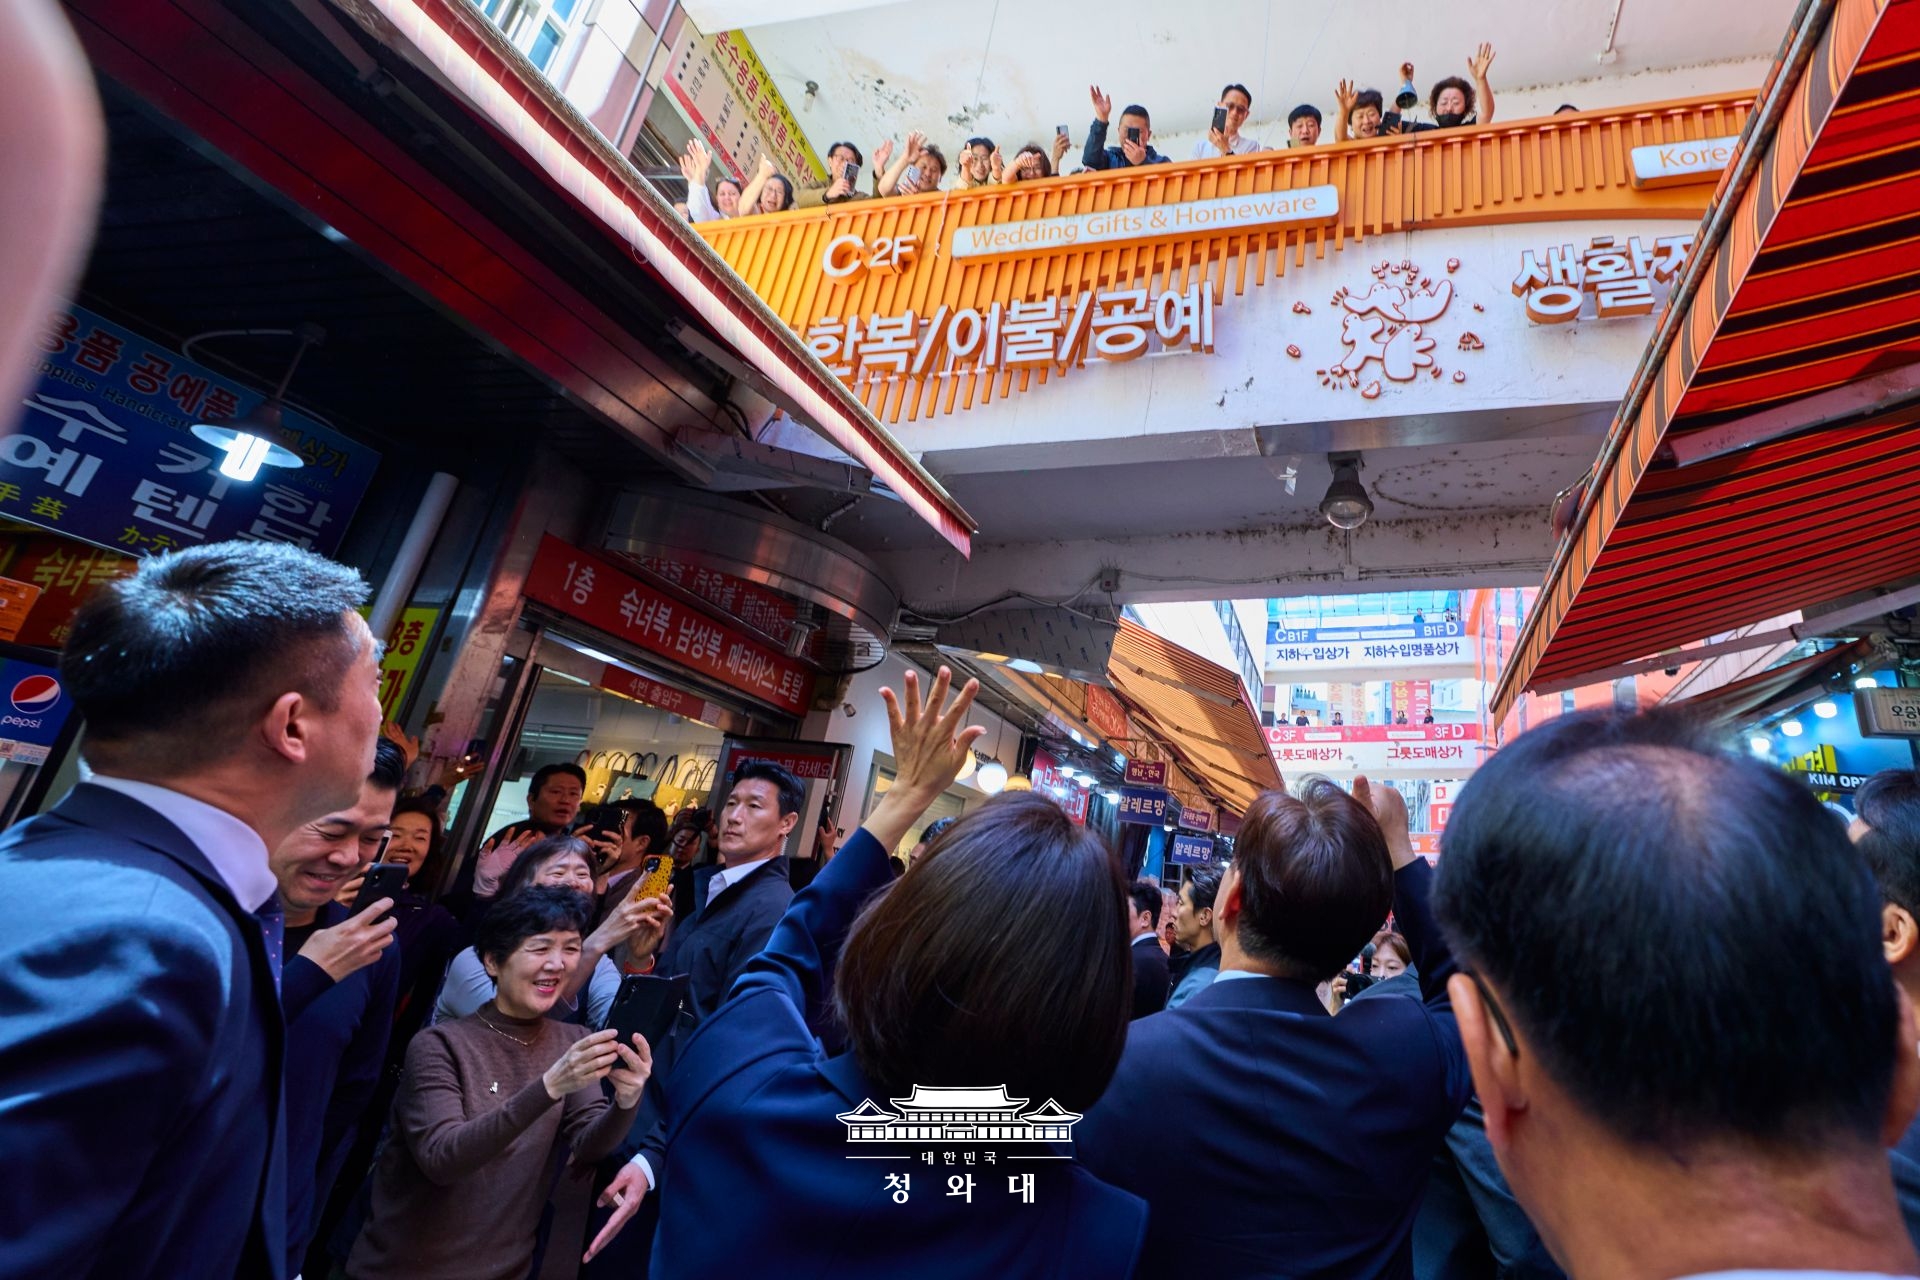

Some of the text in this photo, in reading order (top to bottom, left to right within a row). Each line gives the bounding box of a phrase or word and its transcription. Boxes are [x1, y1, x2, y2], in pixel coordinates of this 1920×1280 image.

[715, 31, 760, 101] 혼수용품
[758, 95, 788, 149] 공예품
[785, 139, 817, 183] 도매상
[1659, 145, 1735, 168] Kore
[971, 195, 1318, 249] Wedding Gifts & Homeware
[45, 310, 128, 377] 용품
[127, 351, 243, 422] 공예품
[117, 524, 182, 554] カーテ
[562, 560, 596, 605] 1층
[619, 587, 673, 648] 숙녀복,
[675, 616, 723, 673] 남성복,
[1276, 642, 1460, 662] 지하수입상가 지하수입명품상가
[628, 680, 682, 711] 4번 출입구
[1, 715, 43, 729] pepsi
[1808, 773, 1837, 787] KIM
[1119, 794, 1166, 818] 알레르망
[1174, 842, 1211, 861] 알레르망
